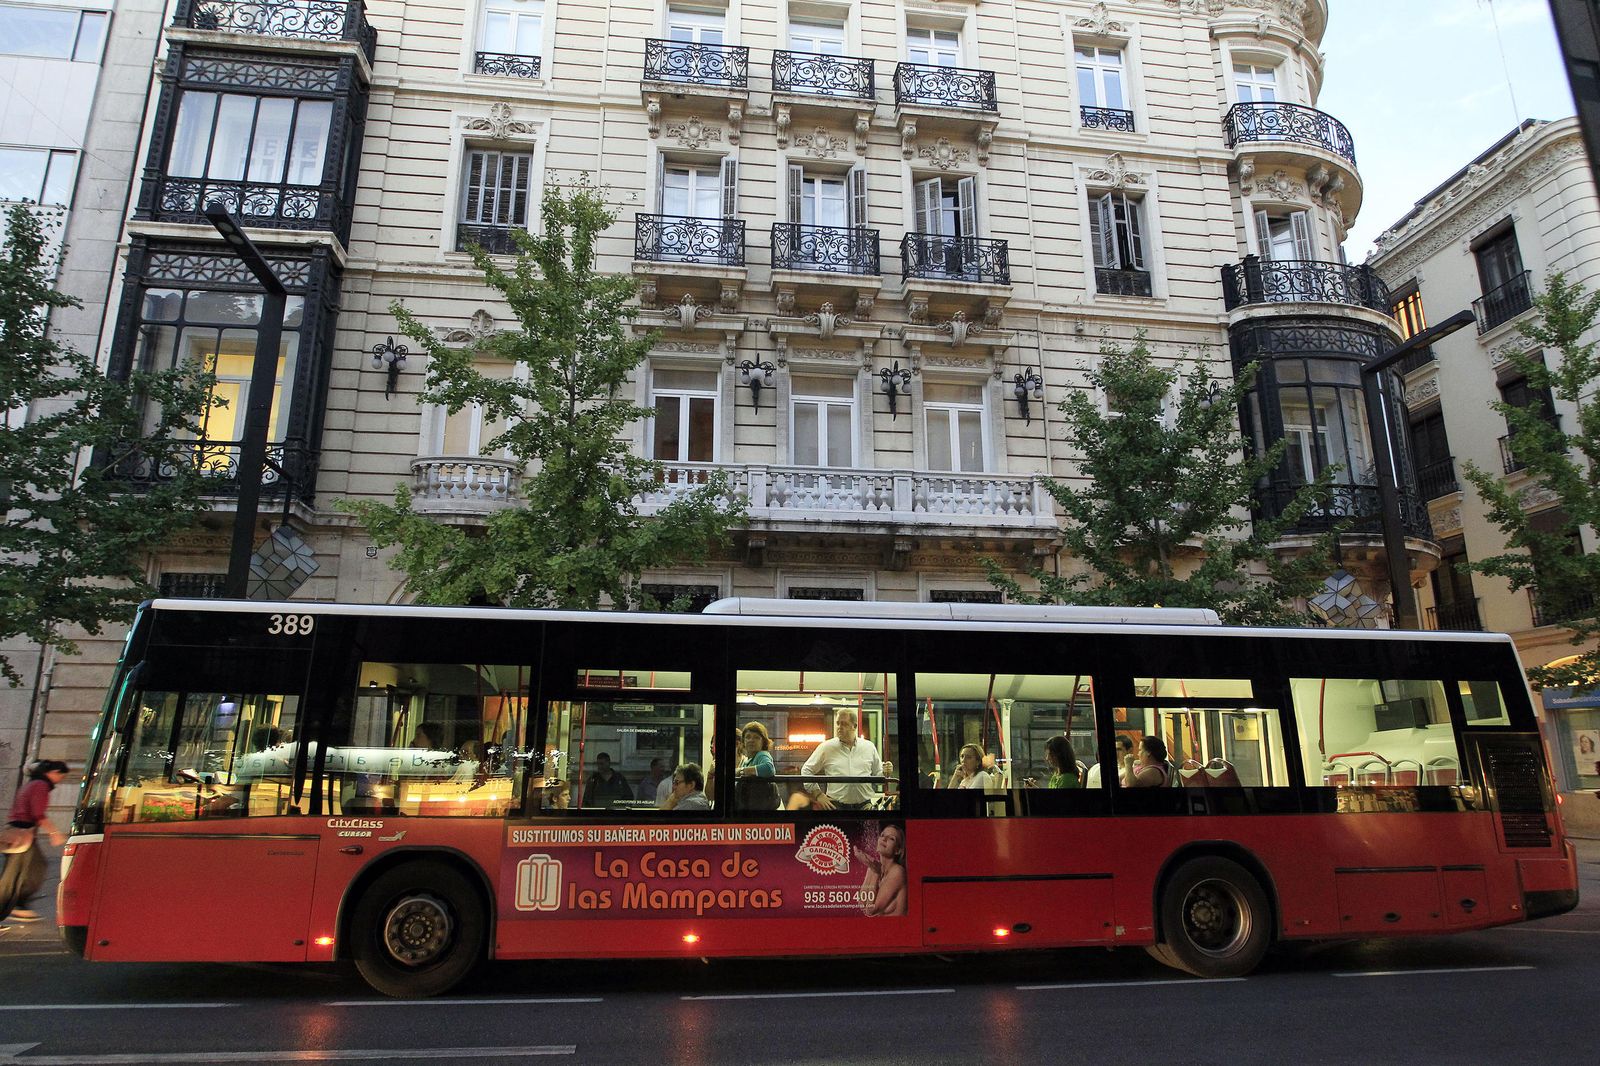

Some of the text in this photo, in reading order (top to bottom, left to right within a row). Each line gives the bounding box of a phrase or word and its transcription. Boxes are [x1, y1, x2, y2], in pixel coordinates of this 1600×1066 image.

[268, 614, 314, 635] 389
[327, 818, 384, 829] CityClass
[512, 825, 792, 843] SUSTITUIMOS SU BAÑERA POR DUCHA EN UN SOLO DÍA
[595, 851, 759, 878] La Casa de
[568, 882, 783, 916] las Mamparas
[804, 890, 875, 903] 958 560 400
